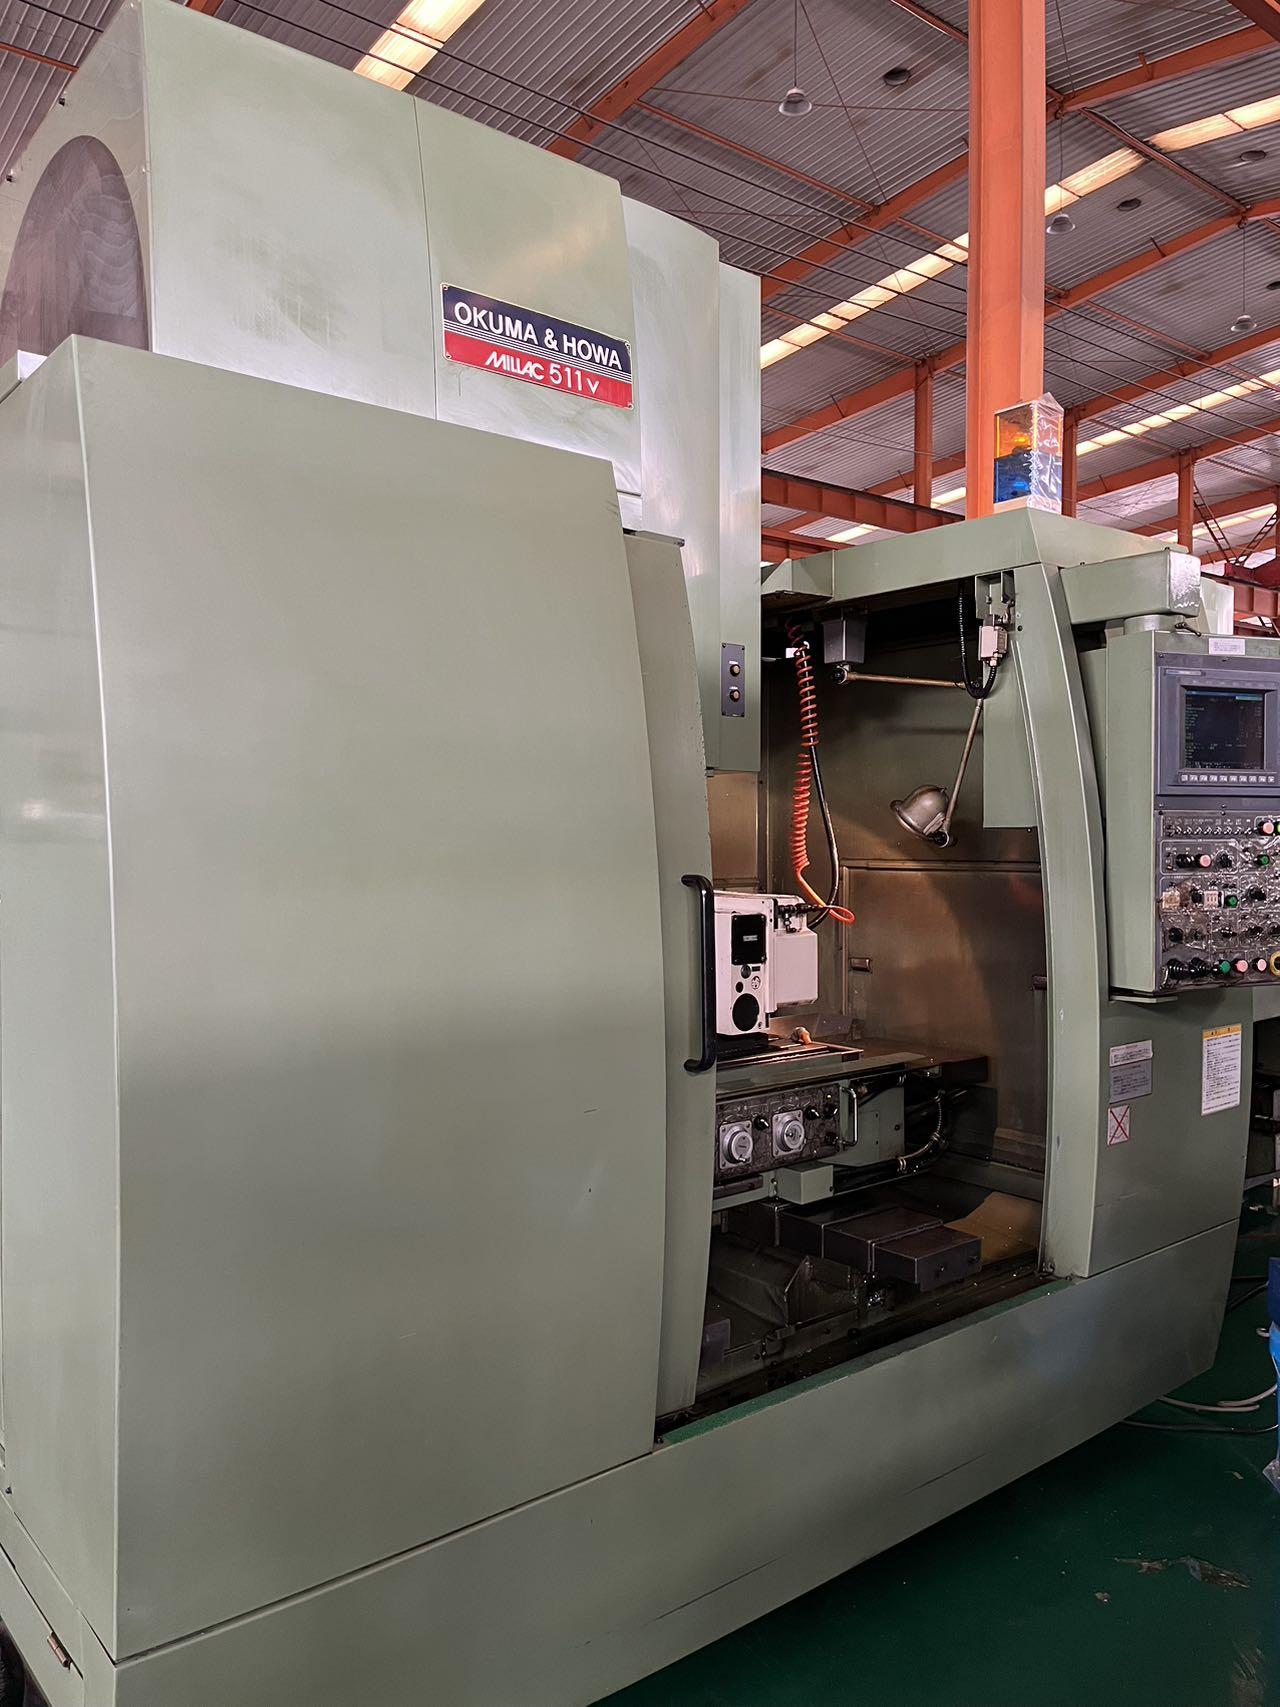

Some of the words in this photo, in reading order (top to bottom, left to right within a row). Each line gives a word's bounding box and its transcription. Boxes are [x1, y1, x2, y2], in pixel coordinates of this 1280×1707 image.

[454, 302, 539, 345] OKUMA
[544, 328, 559, 351] &
[563, 334, 622, 370] HOWA
[485, 351, 545, 381] MILLAC
